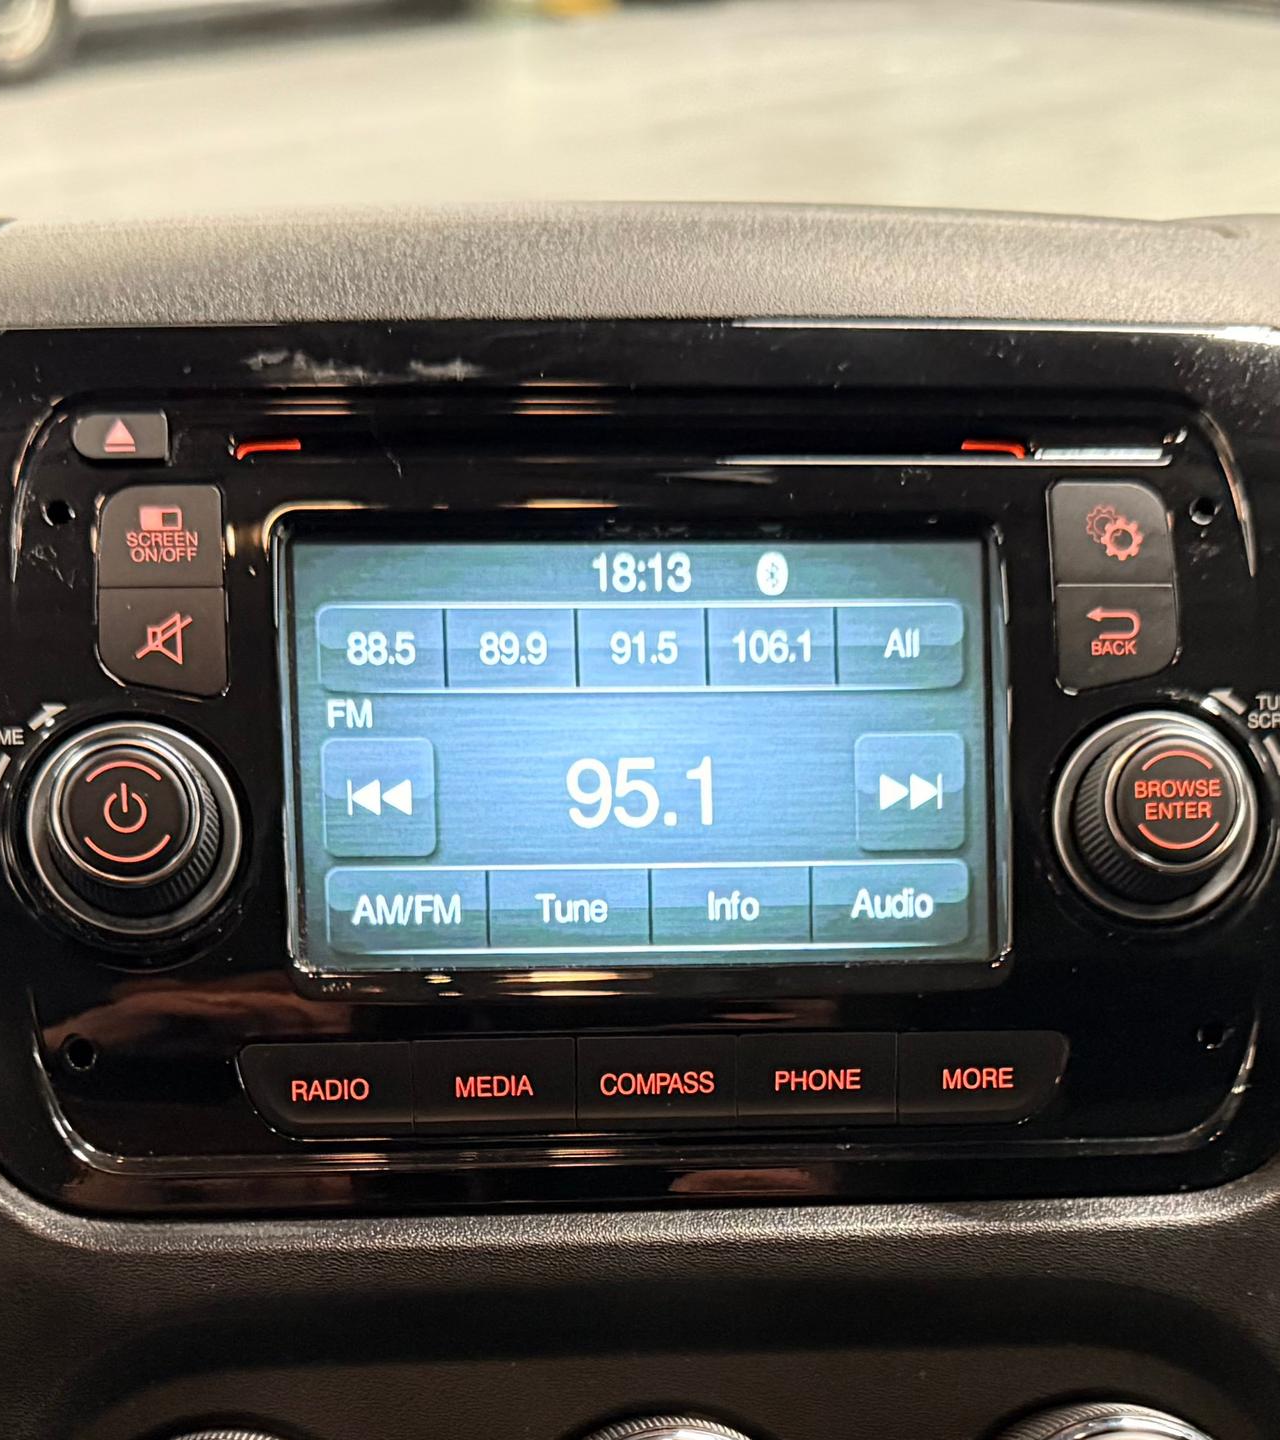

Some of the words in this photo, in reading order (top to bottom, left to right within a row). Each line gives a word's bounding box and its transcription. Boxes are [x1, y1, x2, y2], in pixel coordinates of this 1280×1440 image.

[125, 531, 199, 548] SCREEN
[130, 545, 199, 564] ON/OFF
[591, 551, 694, 594] 18:13
[346, 630, 417, 667] 88.5
[478, 629, 549, 666] 89.9
[610, 629, 679, 666] 91.5
[731, 627, 813, 664] 106.1
[883, 626, 921, 660] All
[1090, 639, 1138, 657] BACK
[326, 699, 374, 730] FM
[565, 754, 717, 832] 95.1
[1133, 778, 1222, 800] BROWSE
[1144, 800, 1213, 822] ENTER
[351, 894, 462, 926] AM/FM
[535, 892, 608, 924] Tune
[706, 889, 760, 922] Info
[850, 886, 934, 920] Audio
[290, 1077, 371, 1102] RADIO
[454, 1074, 535, 1098] MEDIA
[599, 1070, 716, 1096] COMPASS
[773, 1067, 863, 1092] PHONE
[941, 1066, 1015, 1091] MORE
